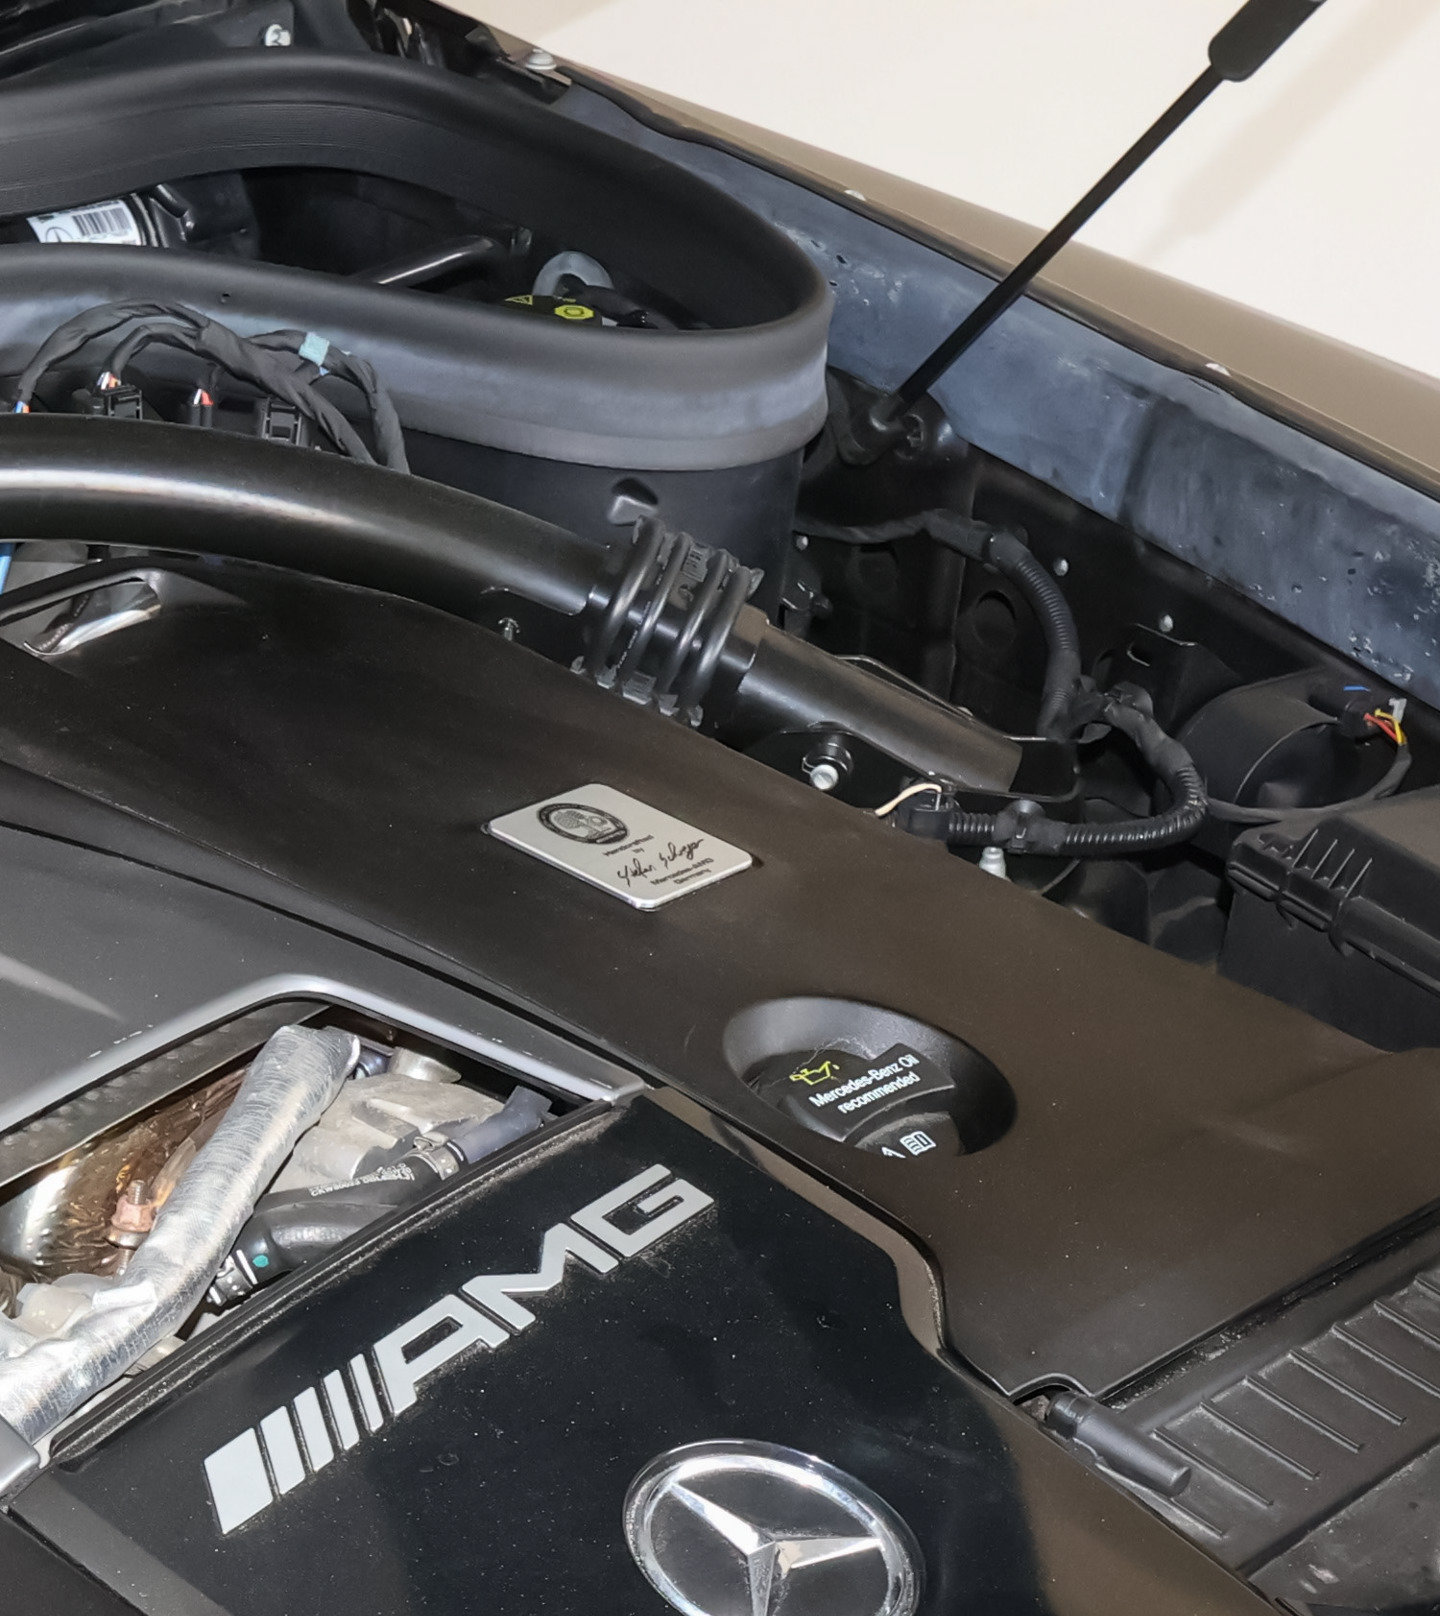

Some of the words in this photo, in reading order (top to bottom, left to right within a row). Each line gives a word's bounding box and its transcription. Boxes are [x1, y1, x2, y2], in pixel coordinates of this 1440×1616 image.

[809, 1063, 904, 1107] Mercedes-Benz
[897, 1053, 920, 1068] Oil
[837, 1070, 921, 1114] recommended
[372, 1163, 715, 1416] AMG
